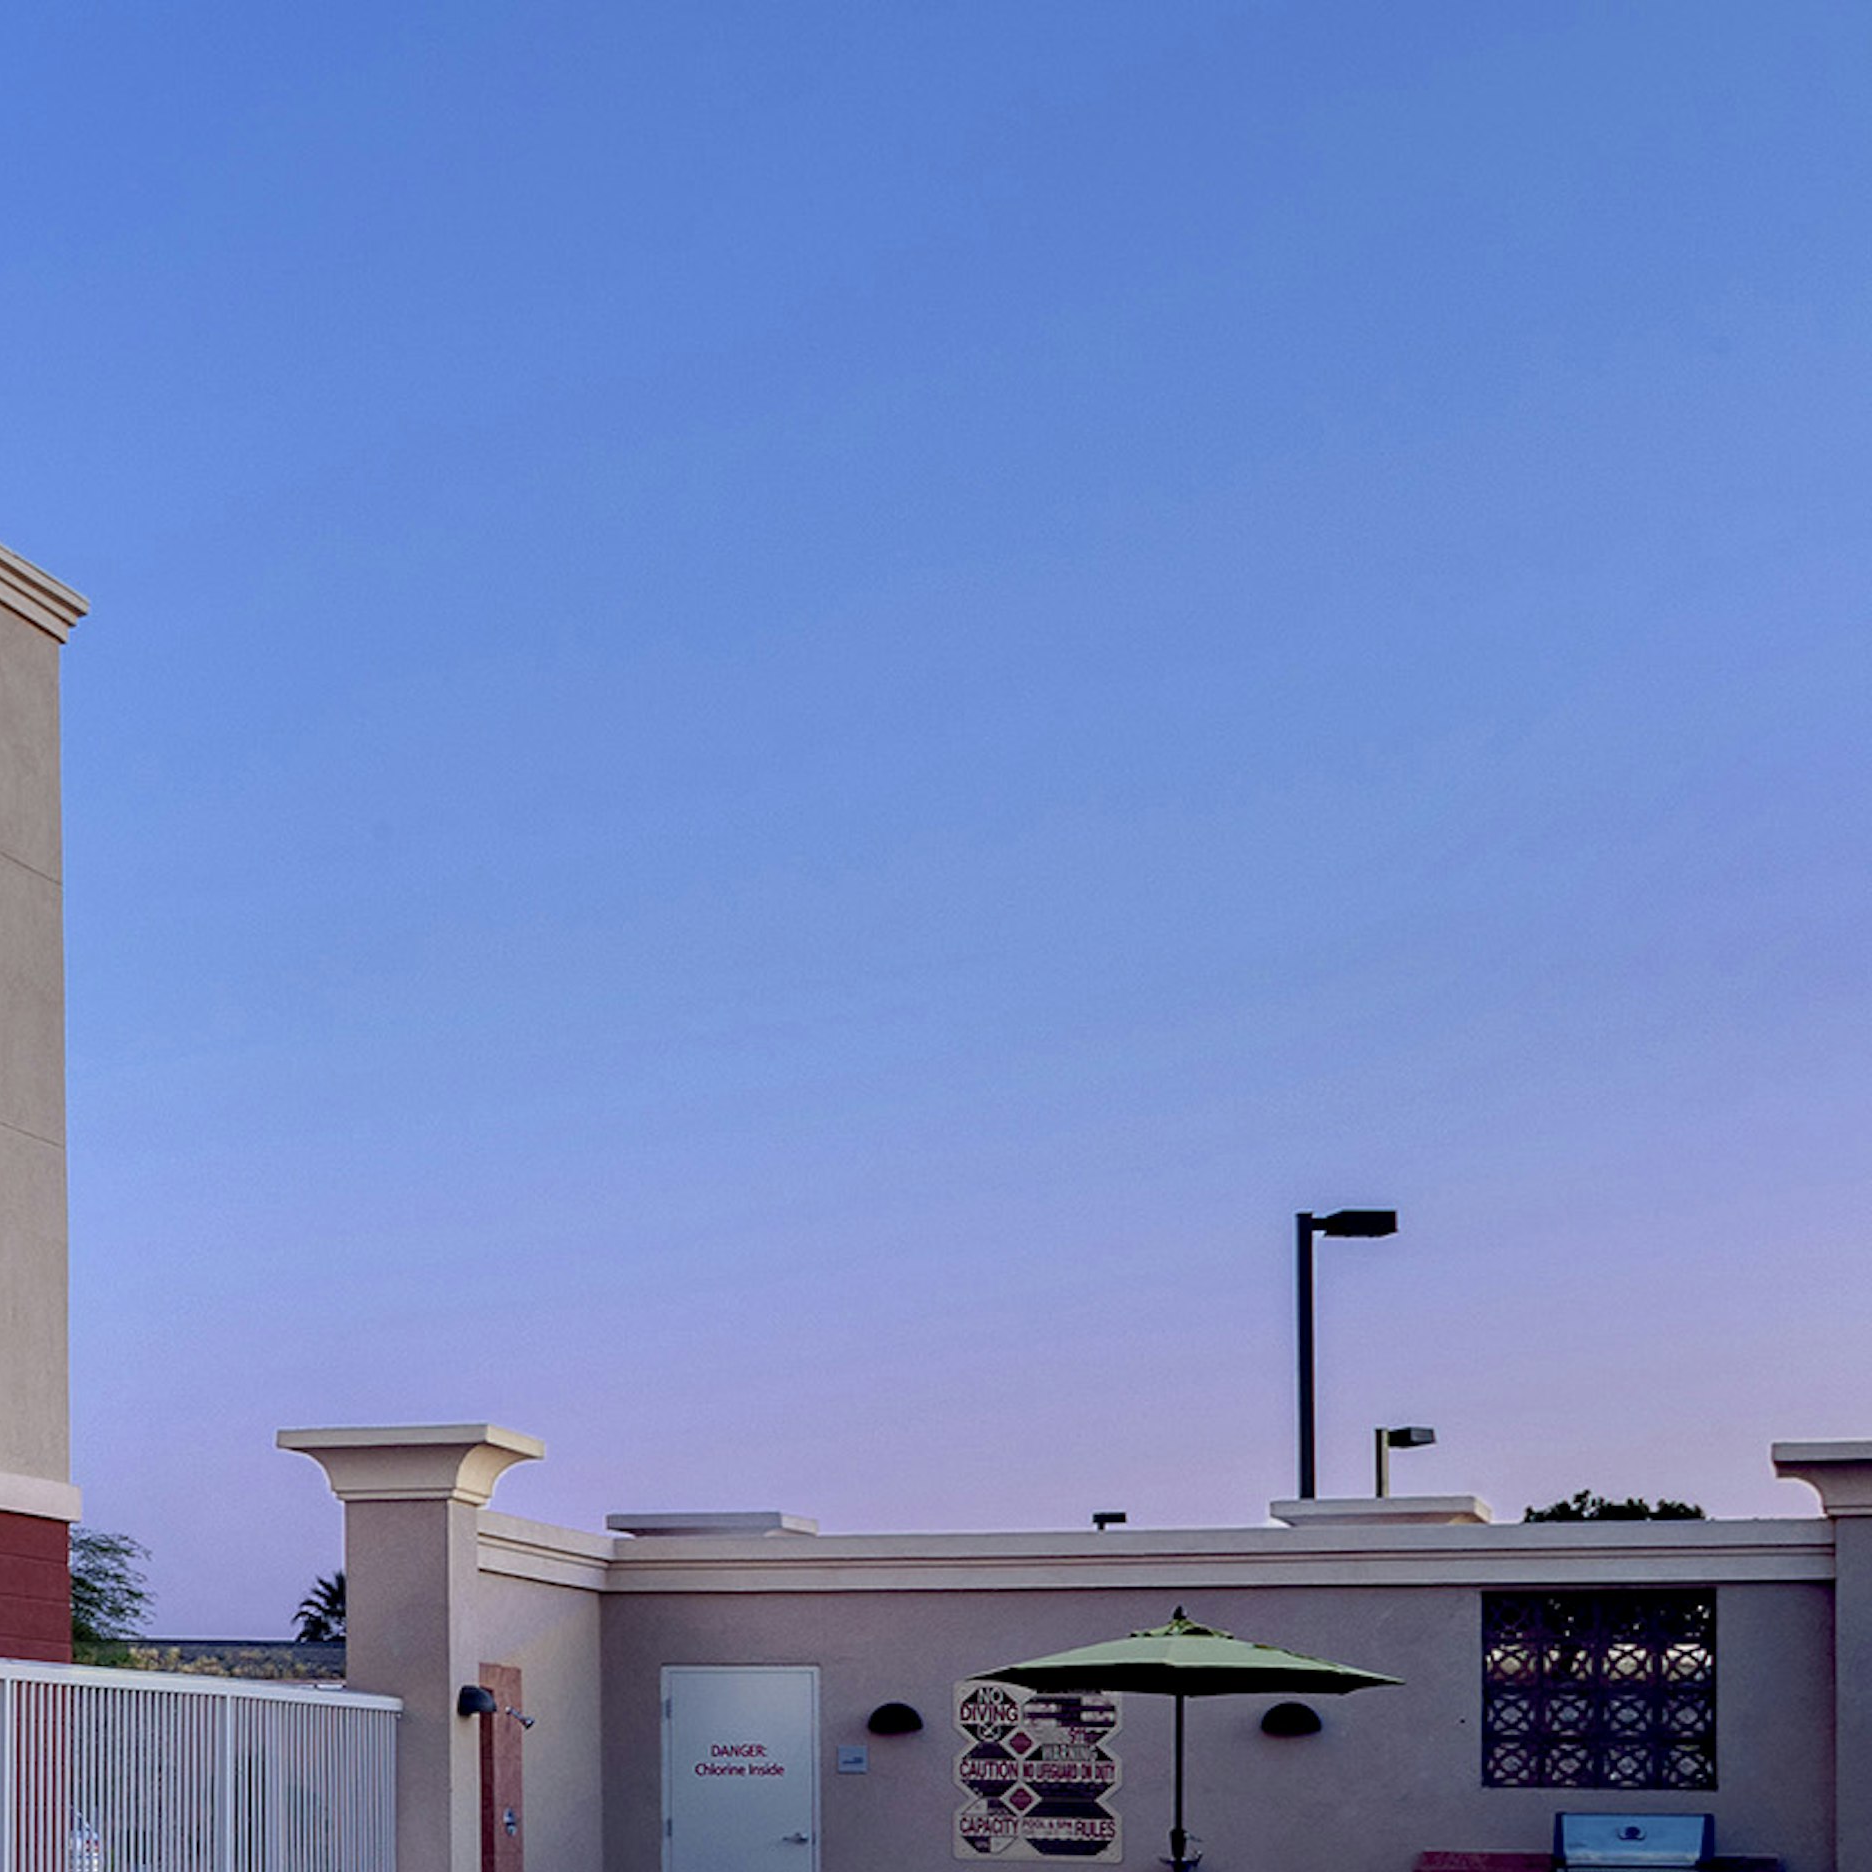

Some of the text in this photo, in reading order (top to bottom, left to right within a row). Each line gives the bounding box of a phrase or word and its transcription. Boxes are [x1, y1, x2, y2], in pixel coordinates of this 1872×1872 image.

[978, 1687, 1003, 1702] NO
[960, 1703, 1019, 1721] DIVING
[694, 1763, 785, 1776] Chlorine Inside
[960, 1760, 1019, 1778] CAUTION
[960, 1817, 1018, 1834] CAPACITY
[1075, 1822, 1116, 1838] RULES
